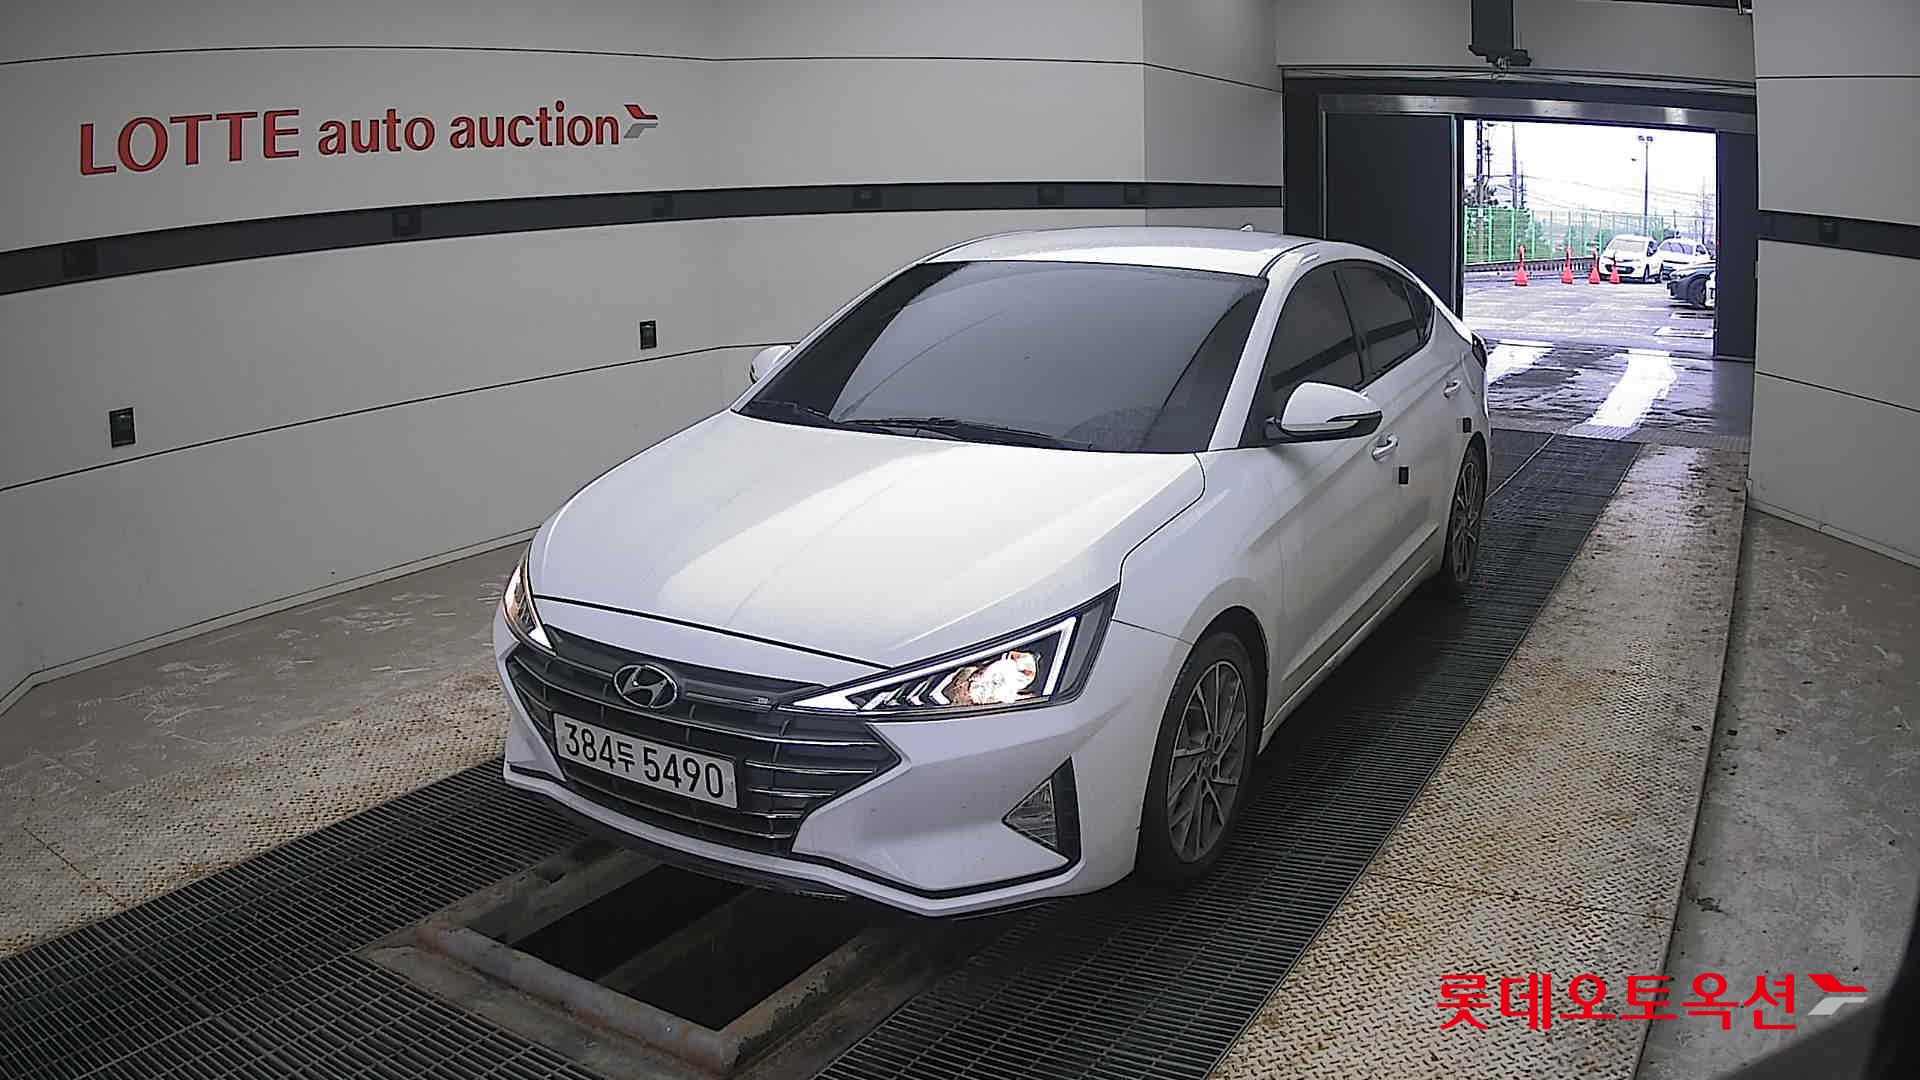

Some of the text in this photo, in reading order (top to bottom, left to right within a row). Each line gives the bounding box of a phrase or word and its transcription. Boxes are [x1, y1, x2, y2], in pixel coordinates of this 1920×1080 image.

[80, 100, 620, 176] LOTTE auto auction
[563, 722, 725, 799] 384두 5490
